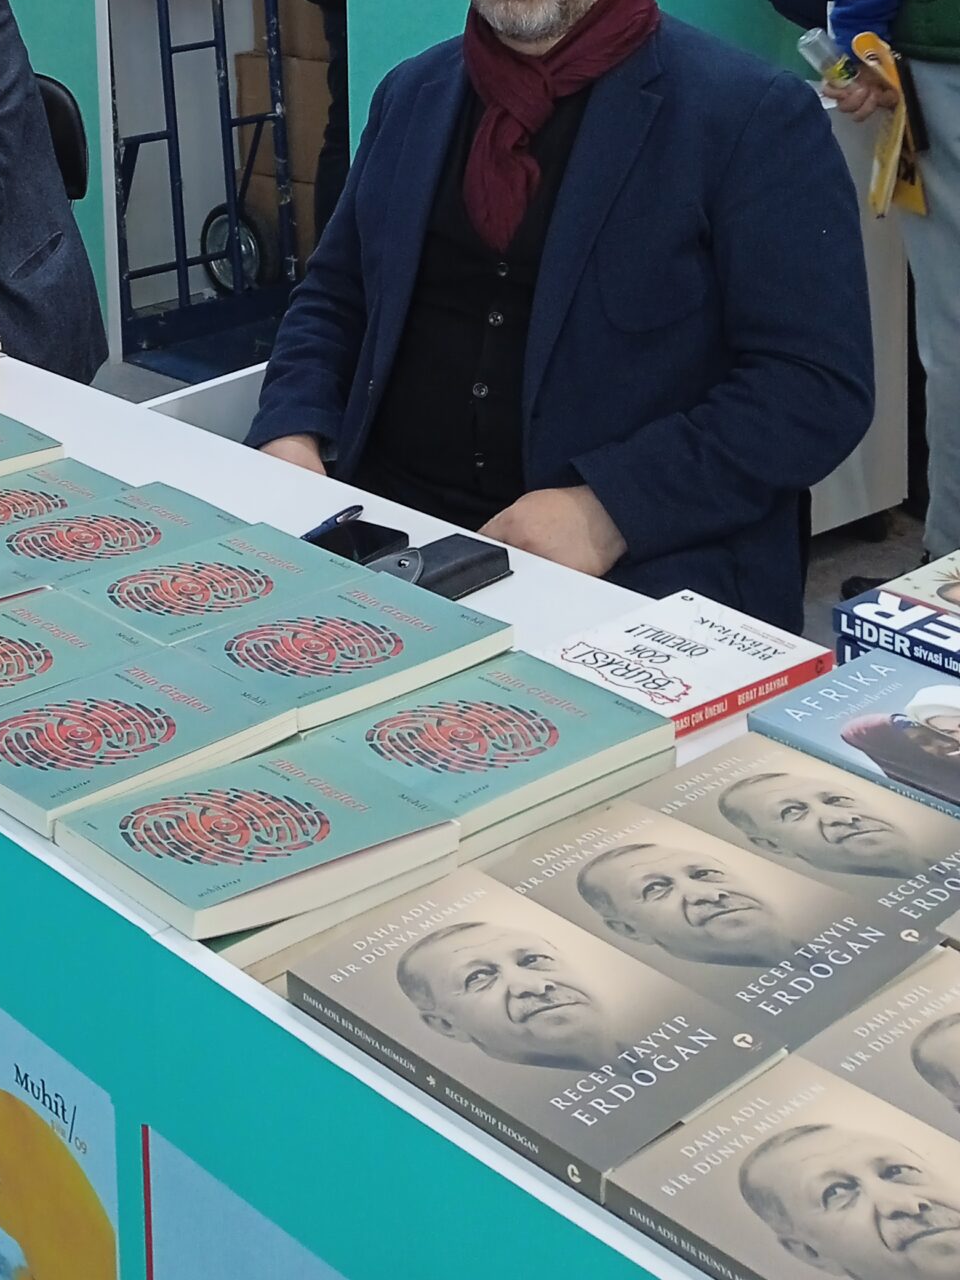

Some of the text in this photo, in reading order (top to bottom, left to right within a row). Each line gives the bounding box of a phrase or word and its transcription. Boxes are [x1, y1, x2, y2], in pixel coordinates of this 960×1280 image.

[572, 648, 675, 692] BURASI
[913, 645, 943, 666] SİYASİ
[736, 687, 758, 706] BERAT
[757, 675, 789, 697] ALBAYRAK
[532, 843, 576, 868] DAHA
[877, 872, 931, 909] RECEP
[353, 923, 400, 952] DAHA
[329, 962, 361, 984] BİR
[735, 915, 859, 1003] RECEP TAYYİP
[758, 926, 887, 1017] ERDOĞAN
[853, 1008, 898, 1039] DAHA
[303, 992, 324, 1012] DAHA
[341, 1018, 354, 1032] BİR
[445, 1087, 470, 1108] RECEP
[470, 1099, 498, 1126] TAYYİP
[497, 1120, 540, 1154] ERDOĞAN
[550, 1015, 691, 1111] RECEP TAYYİP
[571, 1028, 718, 1127] ERDOĞAN
[840, 1050, 870, 1074] BİR
[679, 1121, 731, 1160] DAHA
[661, 1170, 696, 1198] BİR
[629, 1206, 656, 1230] DAHA
[680, 1235, 698, 1258] BİR
